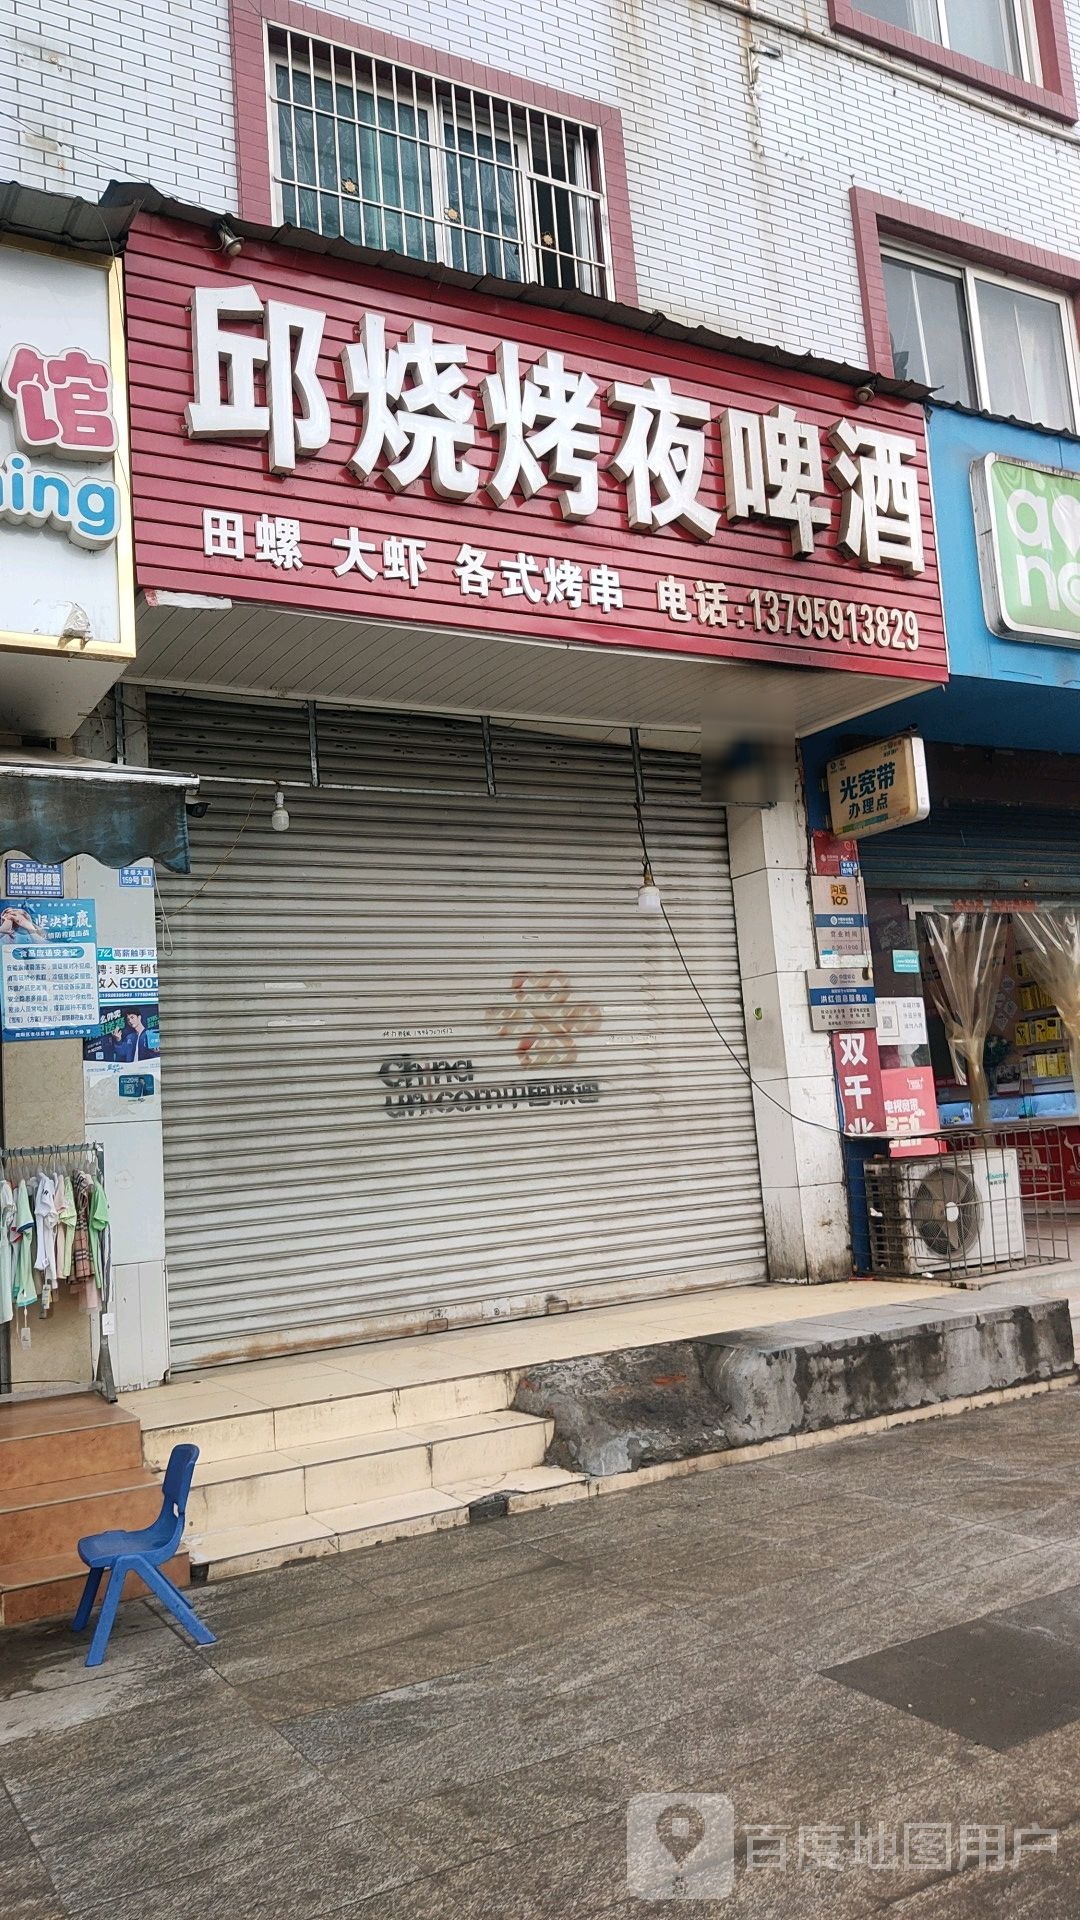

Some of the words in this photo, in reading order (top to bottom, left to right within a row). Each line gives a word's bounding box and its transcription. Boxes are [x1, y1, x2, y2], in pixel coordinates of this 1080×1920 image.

[5, 345, 117, 452] 馆
[184, 285, 924, 578] 邱烧烤夜啤酒
[0, 457, 115, 536] ing
[202, 509, 304, 570] 田螺
[333, 527, 428, 587] 大虾
[455, 544, 624, 613] 各式烤串
[840, 761, 896, 804] 光宽带
[848, 793, 888, 820] 办理点
[831, 884, 847, 895] 沟通
[35, 909, 92, 930] 坚决打赢
[114, 949, 157, 958] 高薪触手可
[378, 1059, 474, 1089] China
